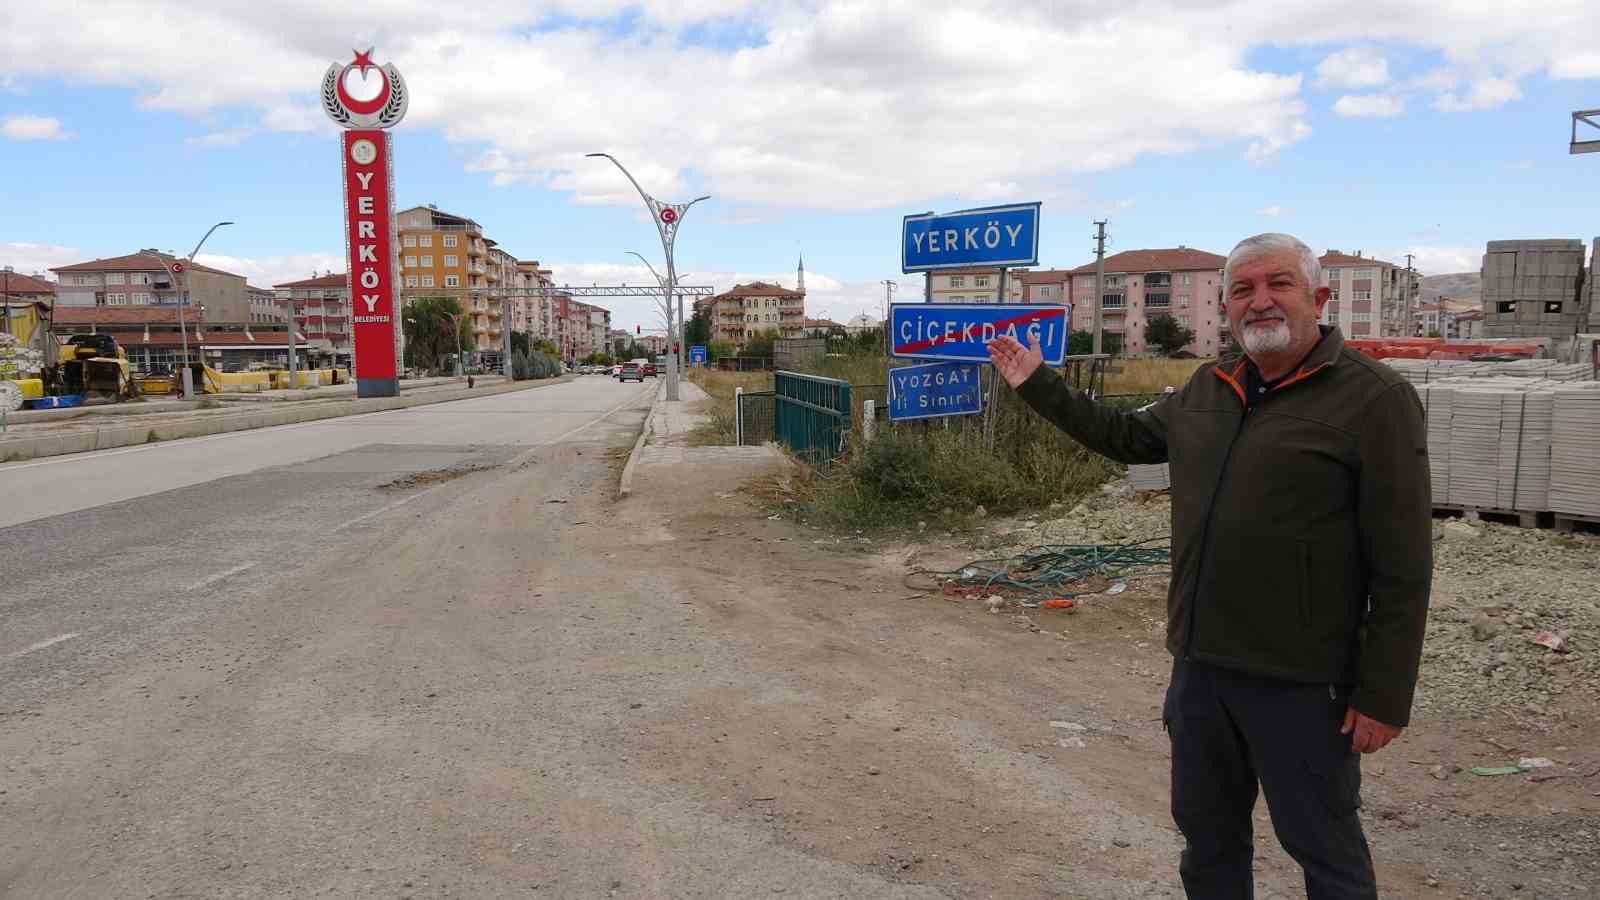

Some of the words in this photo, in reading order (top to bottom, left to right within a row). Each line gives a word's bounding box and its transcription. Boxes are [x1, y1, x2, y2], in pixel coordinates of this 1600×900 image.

[356, 172, 381, 313] YERKÖY
[912, 221, 1023, 253] YERKÖY
[901, 315, 1055, 346] ÇİÇEKDAĞI
[898, 368, 970, 389] YOZGAT
